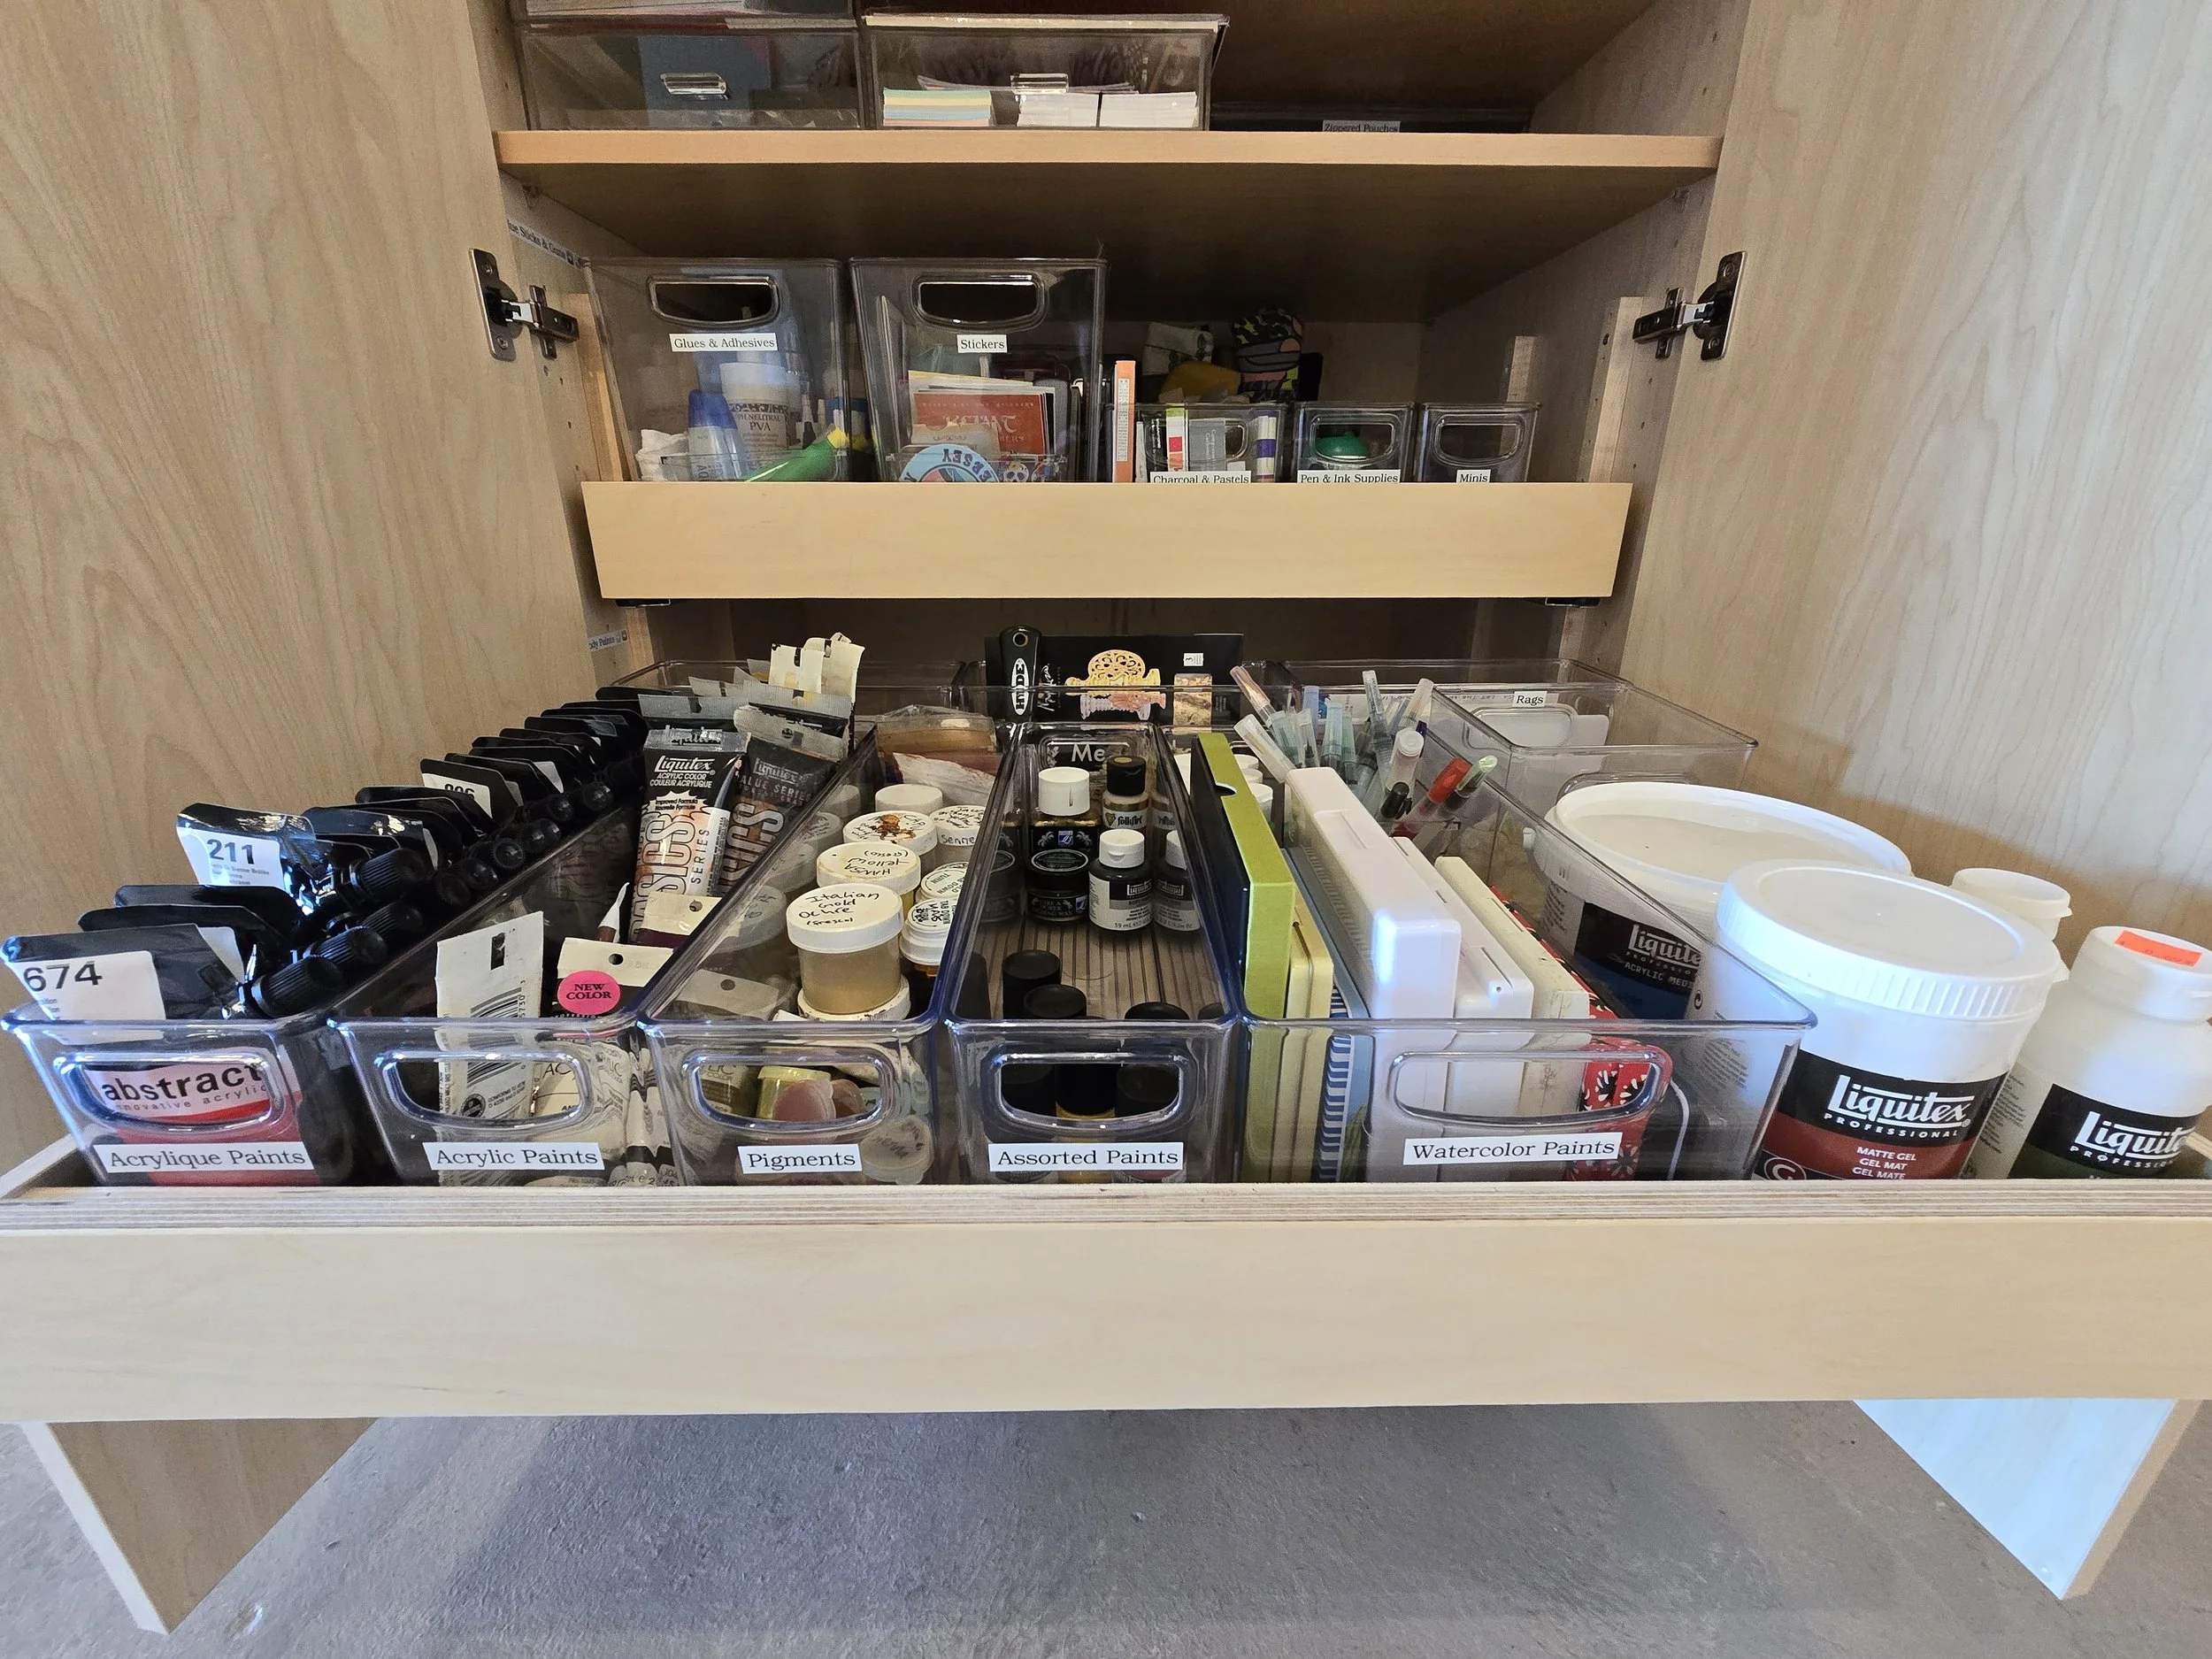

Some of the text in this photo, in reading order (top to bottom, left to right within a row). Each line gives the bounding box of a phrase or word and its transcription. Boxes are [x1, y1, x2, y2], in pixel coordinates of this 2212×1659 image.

[1363, 124, 1399, 133] Pouches
[674, 337, 775, 349] Glues & Adhesives
[960, 338, 1005, 350] Stickers
[749, 421, 772, 432] PVA
[1153, 474, 1198, 483] Charcoal
[1213, 474, 1249, 483] Pastels
[1301, 473, 1398, 483] Pen & Ink Supplies
[1459, 472, 1488, 483] Minis
[1516, 695, 1544, 706] Rags
[1071, 743, 1106, 763] Me
[654, 755, 715, 773] Liquitex
[676, 780, 713, 788] ACRYLIQUE
[206, 838, 255, 865] 211
[691, 828, 710, 885] SERIES
[23, 960, 104, 993] 674
[1624, 961, 1664, 981] ACRYLIC
[566, 991, 612, 1001] COLOR
[102, 1064, 264, 1101] abstract
[1826, 1073, 1976, 1128] Liquitex
[1824, 1112, 1958, 1139] PROFESSIONAL
[998, 1149, 1179, 1165] Assorted Paints
[1413, 1138, 1616, 1160] Watercolor Paints
[1856, 1146, 1916, 1162] MATTE GEL
[111, 1149, 306, 1170] Acrylique Paints
[436, 1148, 598, 1168] Acrylic Paints
[747, 1152, 856, 1171] Pigments
[1859, 1157, 1908, 1171] GEL MAT
[1852, 1166, 1906, 1179] GEL MATE
